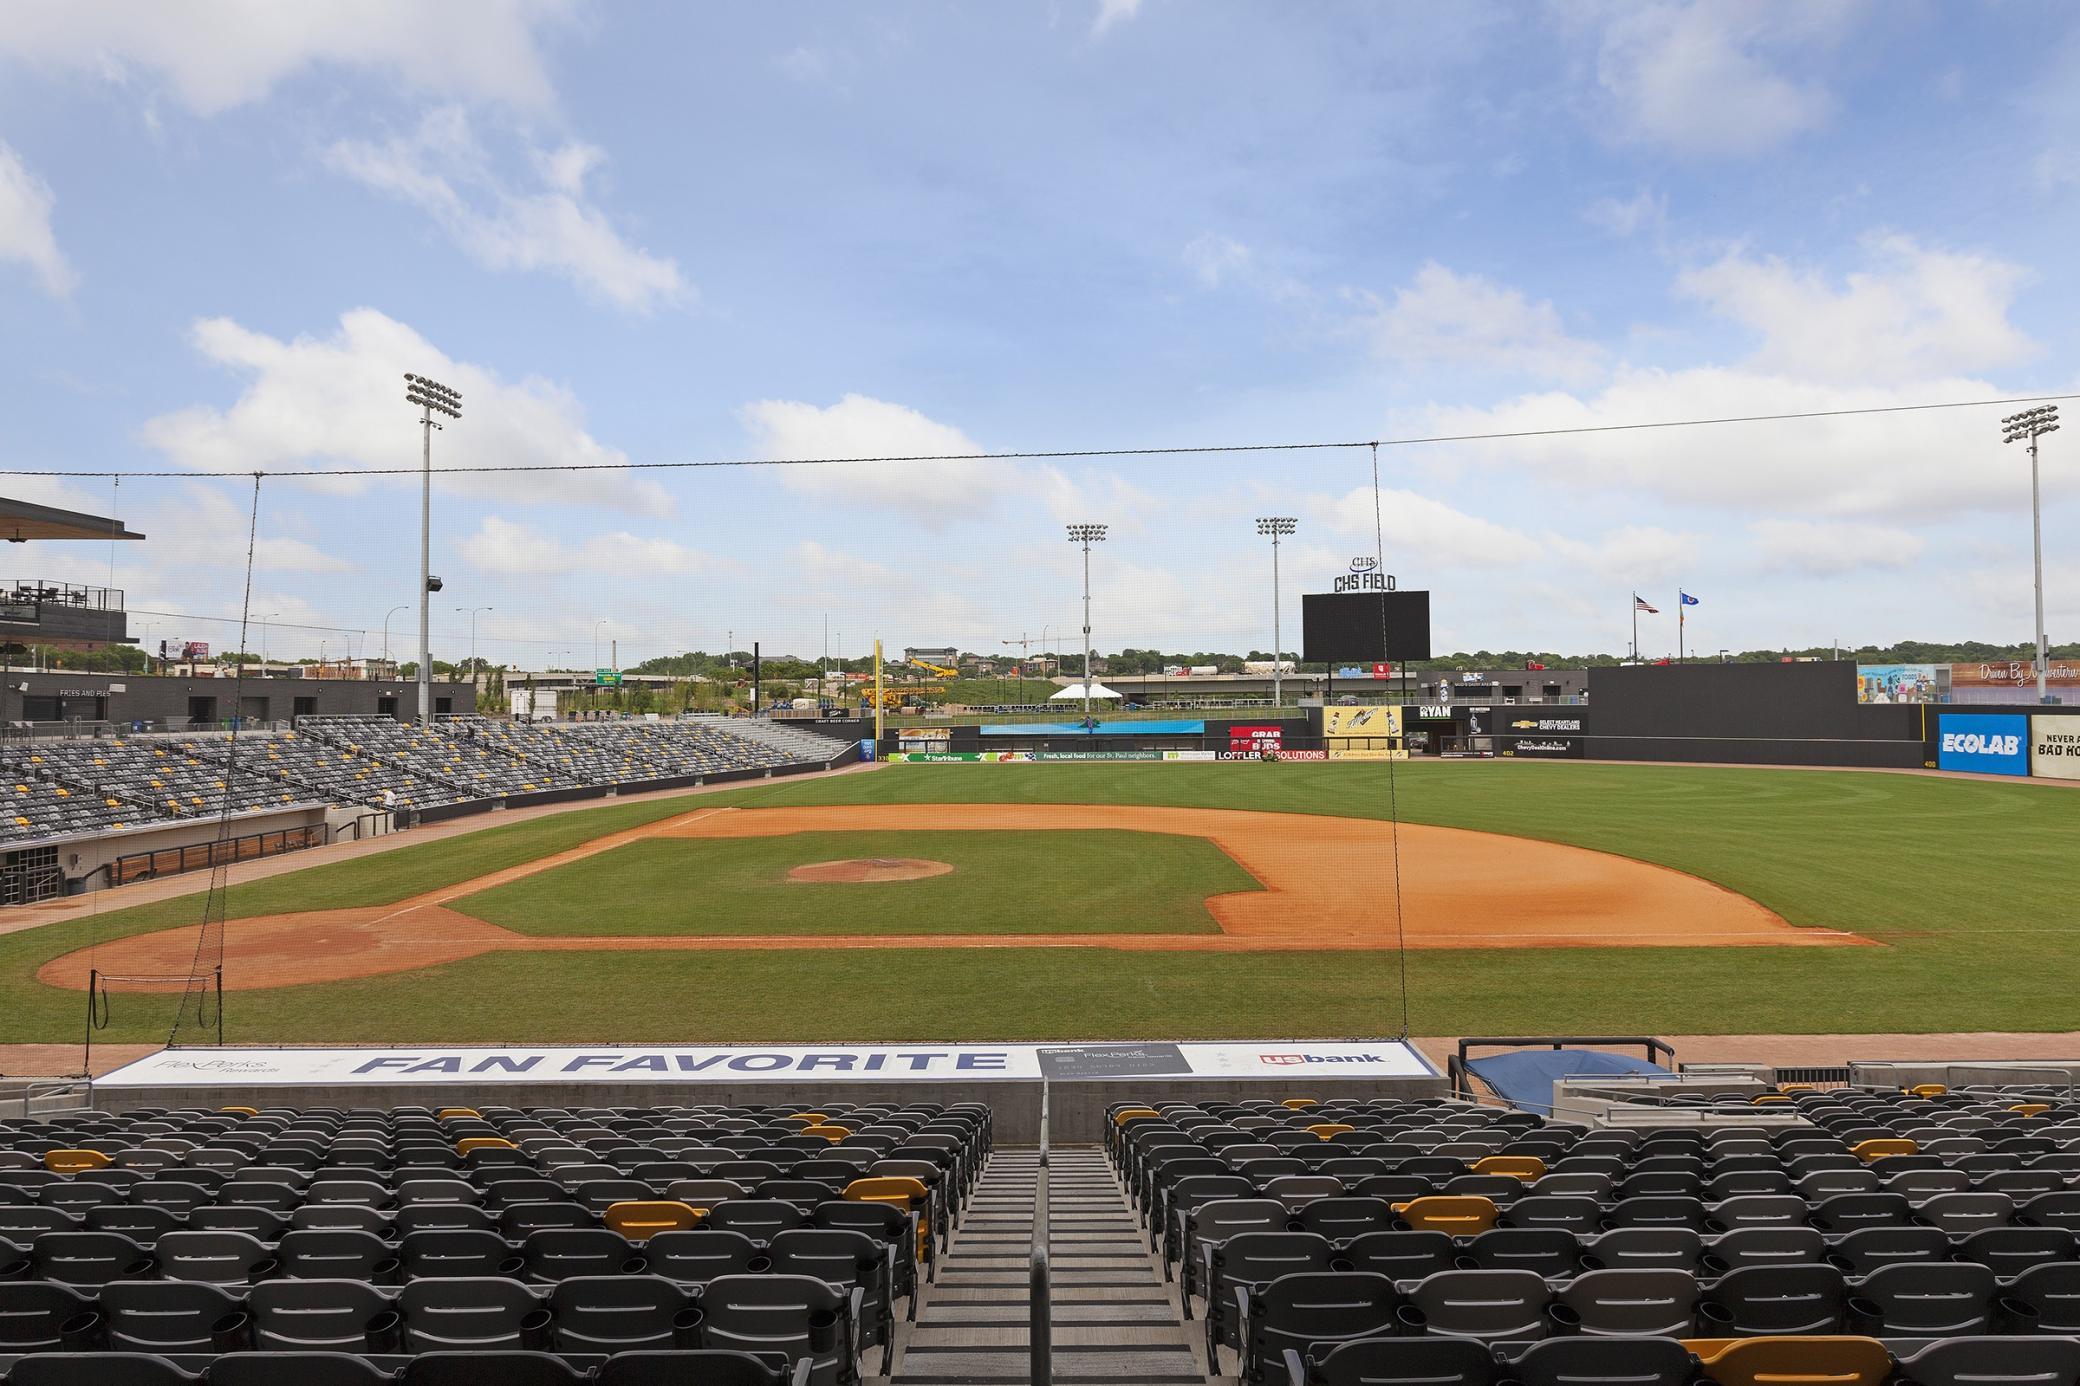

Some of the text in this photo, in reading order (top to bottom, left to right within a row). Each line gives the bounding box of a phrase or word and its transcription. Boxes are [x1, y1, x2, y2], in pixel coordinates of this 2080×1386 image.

[1352, 556, 1376, 567] CHS
[1334, 573, 1396, 593] CHS FIELD
[1979, 663, 2008, 679] Driven
[2009, 662, 2024, 687] By
[60, 689, 79, 697] FRIES
[81, 689, 94, 697] AND
[1419, 706, 1451, 718] RYAN
[1942, 733, 2018, 756] ECOLAB
[2046, 734, 2075, 743] NEVER
[1218, 750, 1324, 760] LOFFLER SOLUTIONS
[2038, 744, 2063, 756] BAD
[349, 1053, 1008, 1073] FAN FAVORITE
